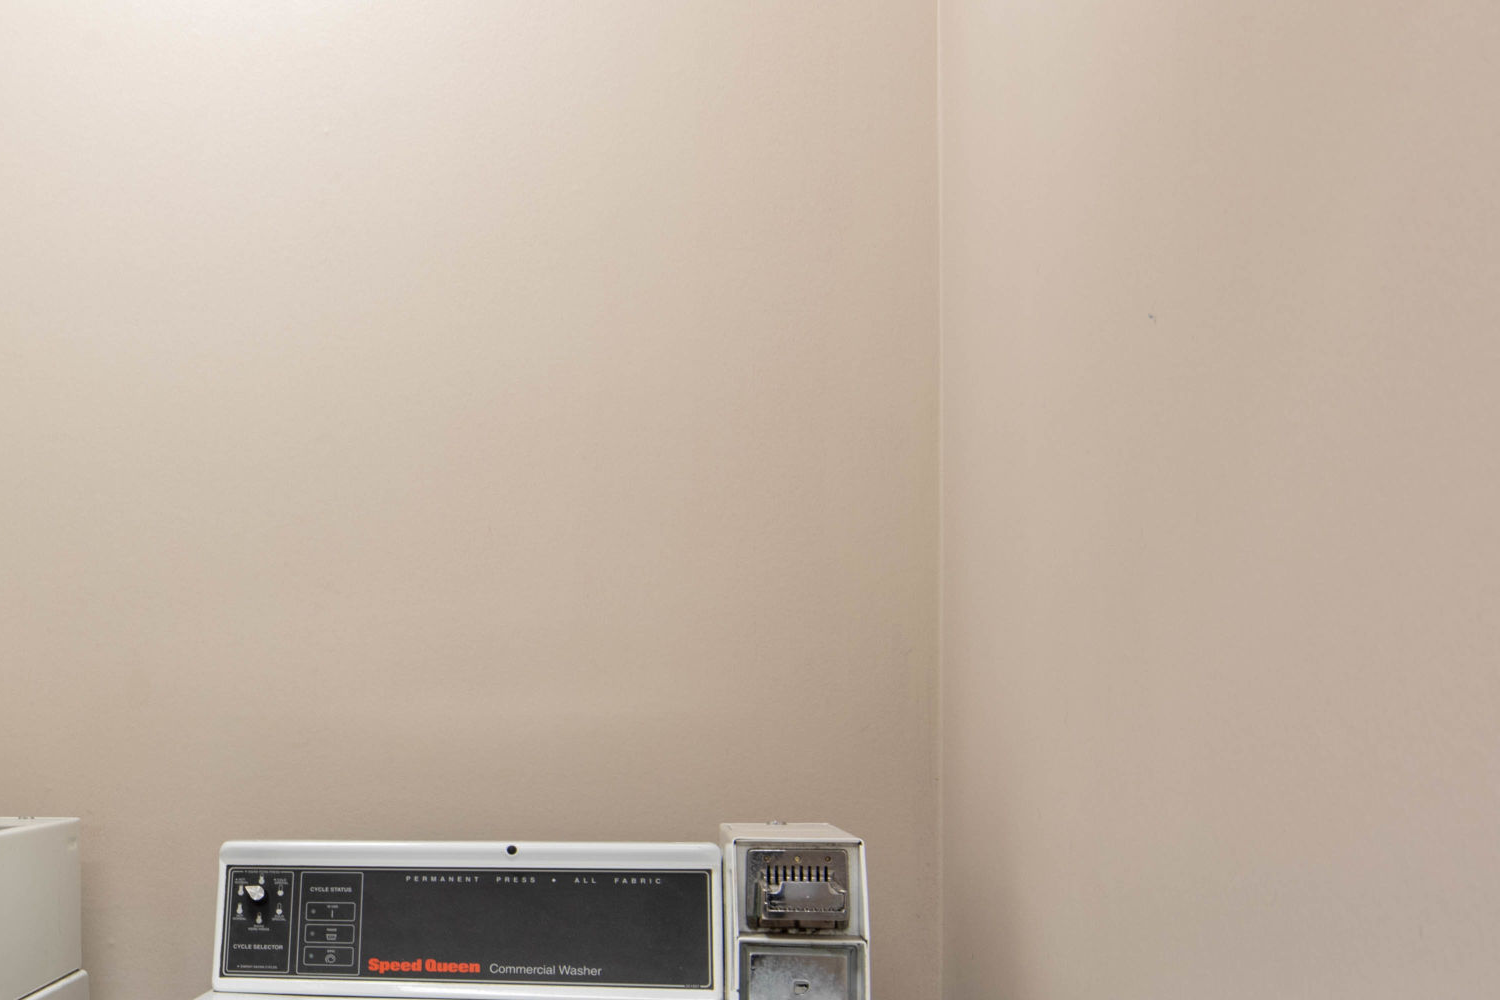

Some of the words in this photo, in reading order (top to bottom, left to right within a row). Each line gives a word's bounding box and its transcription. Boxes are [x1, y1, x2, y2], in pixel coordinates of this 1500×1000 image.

[368, 958, 422, 973] Speed
[425, 959, 481, 973] Queen
[489, 963, 556, 975] Commercial
[558, 965, 602, 976] Washer
